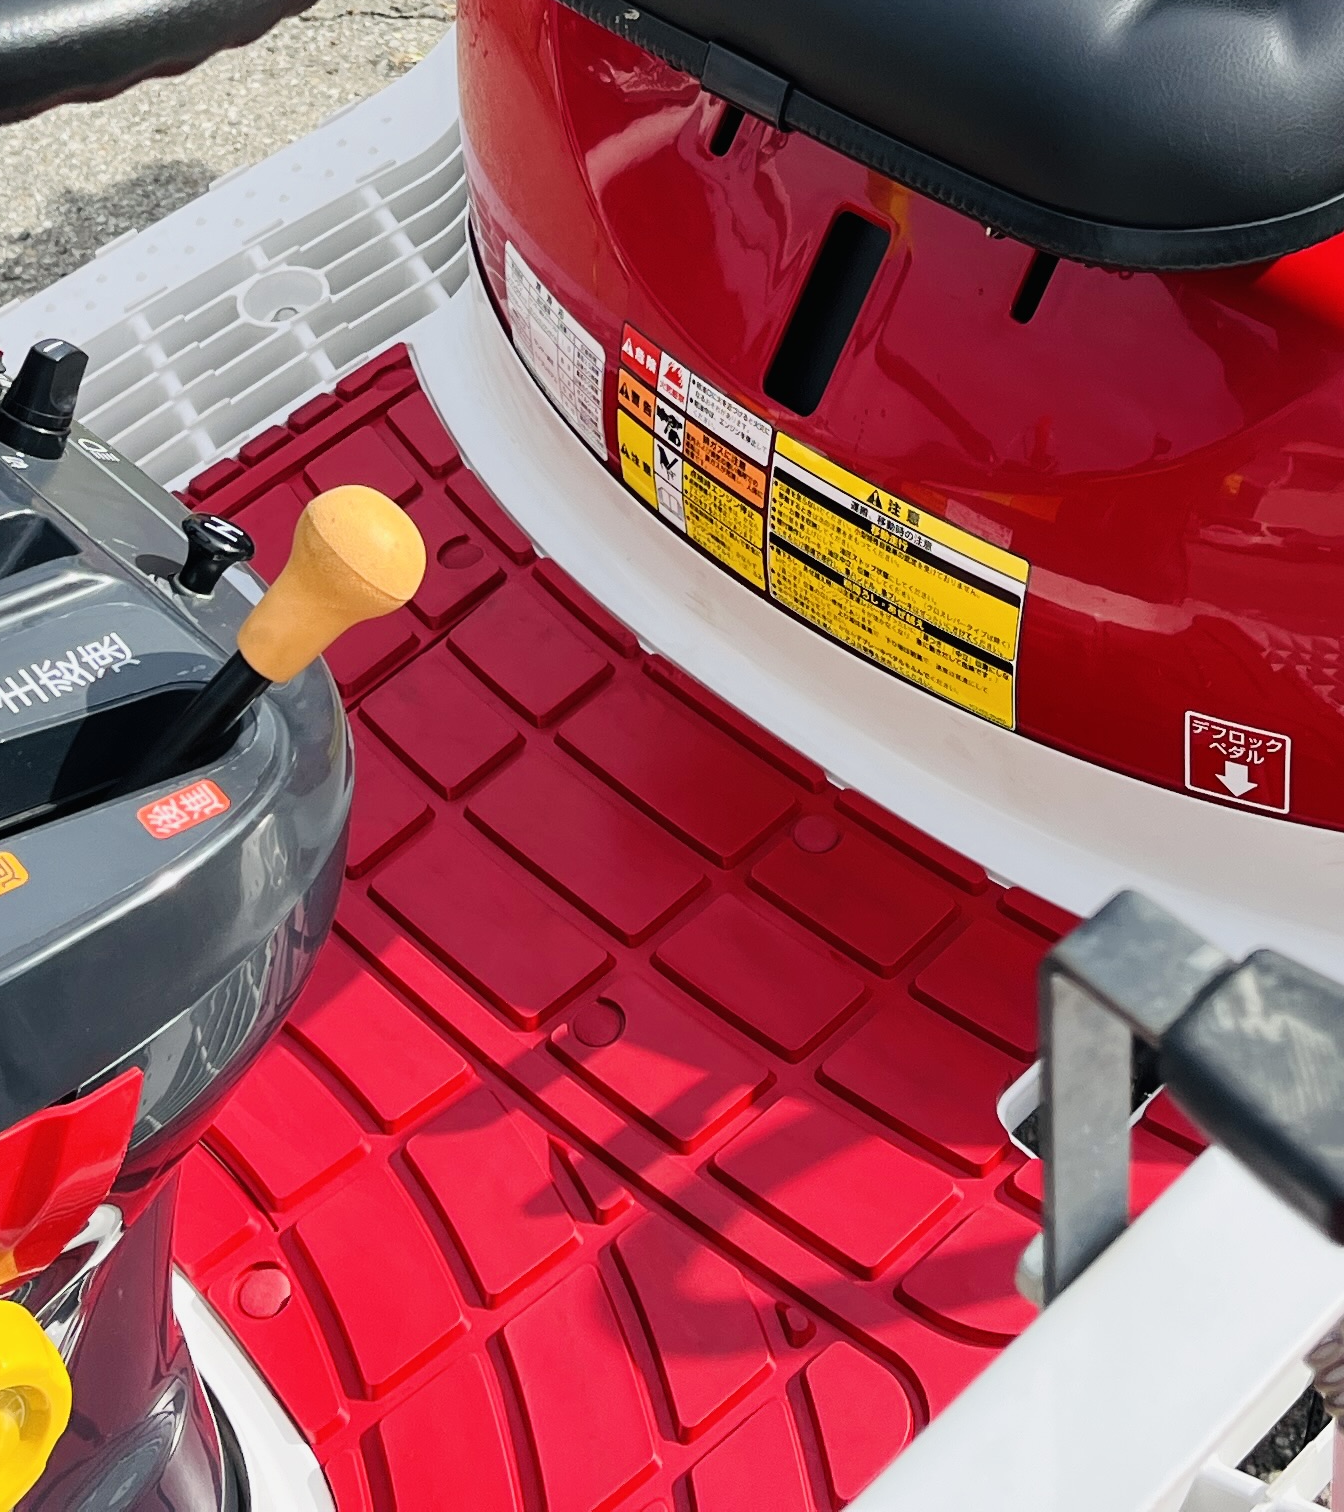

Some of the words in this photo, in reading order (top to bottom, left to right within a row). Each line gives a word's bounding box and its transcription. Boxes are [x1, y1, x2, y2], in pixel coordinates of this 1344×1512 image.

[635, 347, 657, 375] 危険
[632, 390, 652, 419] 警告
[887, 498, 920, 528] 注意
[1192, 719, 1283, 753] デフロック
[1209, 742, 1264, 764] ペダル
[147, 783, 226, 836] 後進
